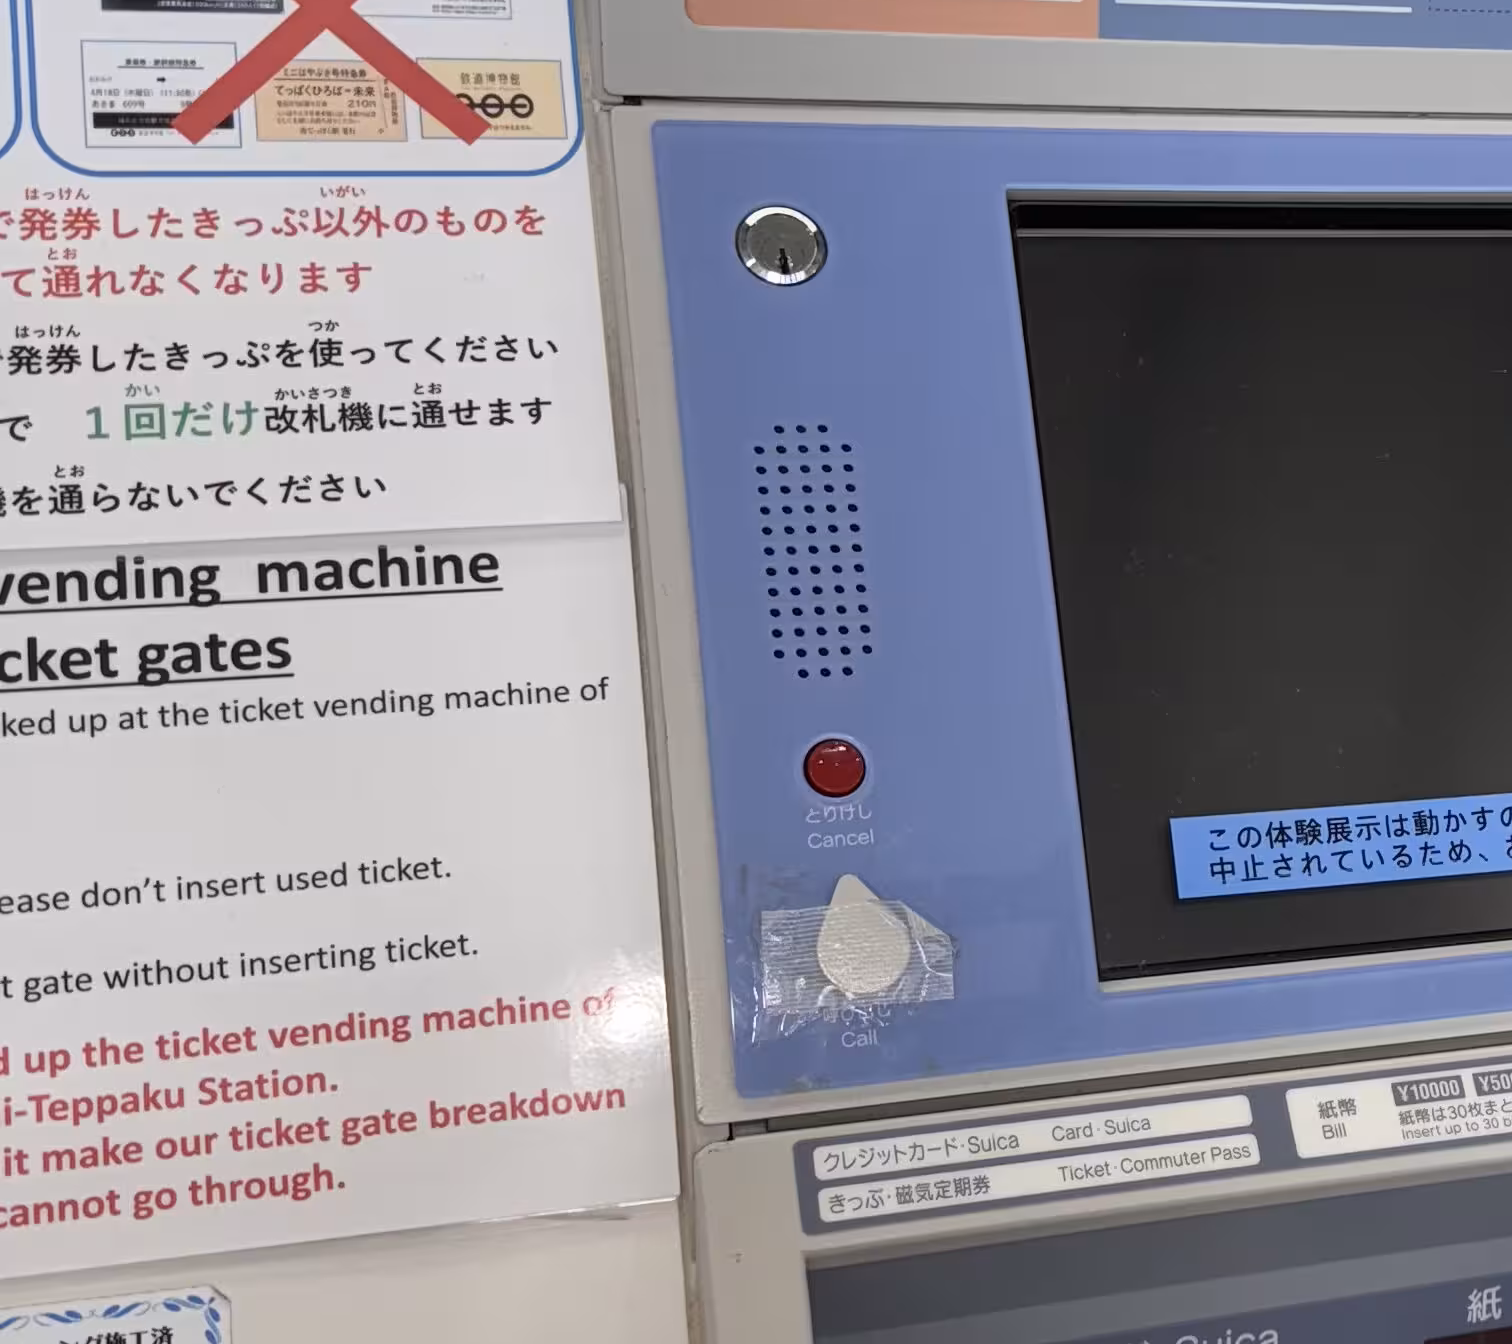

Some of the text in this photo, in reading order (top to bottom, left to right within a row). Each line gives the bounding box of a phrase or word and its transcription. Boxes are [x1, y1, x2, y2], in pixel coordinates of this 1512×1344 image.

[25, 187, 90, 201] はっけん
[320, 185, 366, 199] いがい
[47, 248, 77, 260] とお
[1, 262, 372, 298] て通れなくなります
[15, 325, 81, 338] はっけん
[308, 320, 340, 333] つか
[125, 383, 161, 397] かい
[275, 386, 352, 401] かいさつき
[413, 382, 442, 396] とお
[54, 465, 85, 478] とお
[257, 544, 500, 593] machine
[138, 634, 292, 686] gates
[68, 713, 109, 739] up
[118, 706, 148, 730] at
[158, 702, 209, 727] the
[219, 697, 305, 724] ticket
[313, 690, 435, 719] vending
[444, 682, 571, 711] machine
[579, 677, 609, 704] of
[807, 829, 875, 849] Cancel
[81, 877, 166, 909] don’t
[176, 871, 266, 901] insert
[275, 862, 349, 893] used
[357, 855, 451, 886] ticket.
[23, 934, 479, 1003] gate without inserting ticket.
[25, 1047, 71, 1079] up
[82, 1038, 144, 1069] the
[155, 1025, 257, 1059] ticket
[268, 1011, 411, 1048] vending
[423, 997, 571, 1033] machine
[841, 1029, 878, 1048] Call
[198, 1070, 338, 1106] Station.
[1398, 1078, 1461, 1102] ¥10000
[1317, 1098, 1357, 1120] 紙幣
[3, 1084, 626, 1177] it make our ticket gate breakdown
[1322, 1123, 1347, 1140] Bill
[1401, 1124, 1441, 1141] Insert
[1445, 1123, 1462, 1137] up
[1466, 1120, 1479, 1133] to
[1484, 1117, 1499, 1130] 30
[1210, 1143, 1252, 1163] Pass
[132, 1188, 177, 1220] go
[189, 1161, 346, 1208] through.
